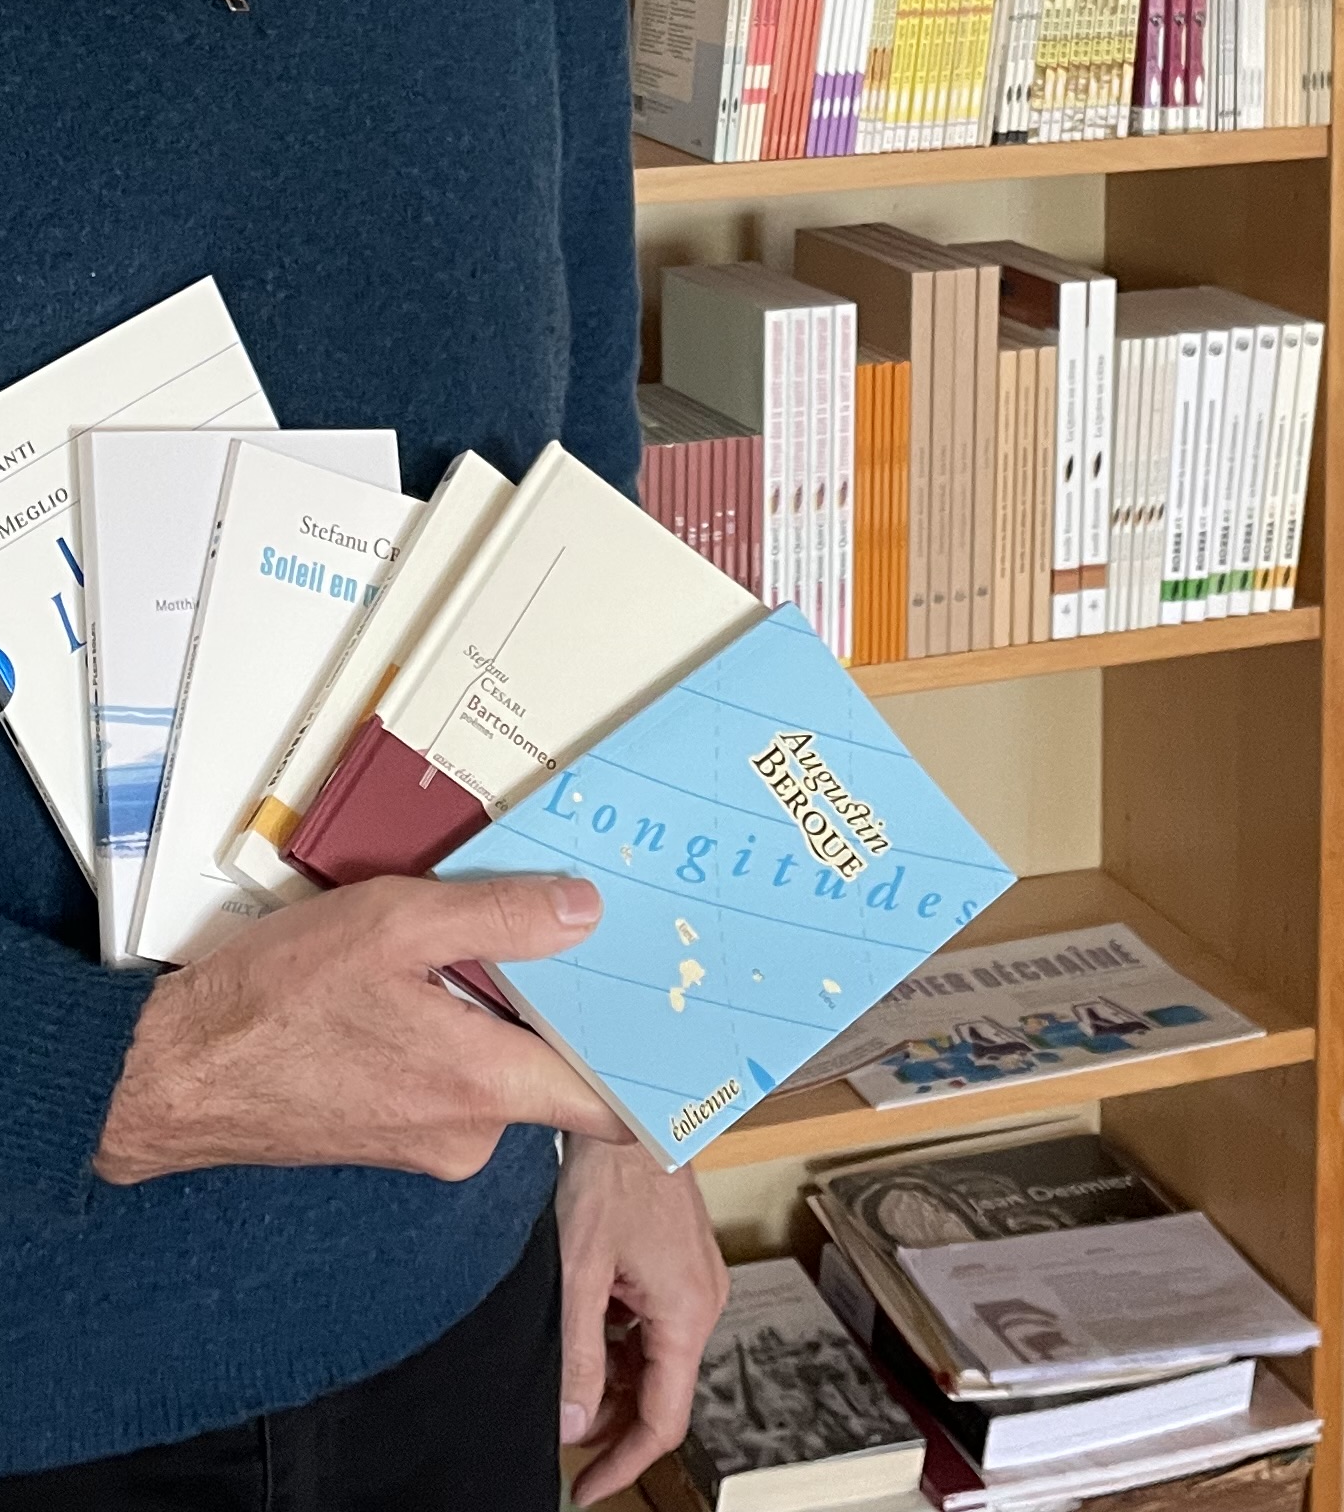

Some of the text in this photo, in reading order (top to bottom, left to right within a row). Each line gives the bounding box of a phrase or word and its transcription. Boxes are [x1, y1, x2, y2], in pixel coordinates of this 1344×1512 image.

[299, 514, 368, 555] Stefanu
[259, 545, 326, 594] Soleil
[329, 573, 358, 604] en
[463, 644, 510, 685] Stefanu
[479, 676, 527, 719] CESARI
[466, 693, 557, 772] Bartolomeo
[454, 764, 497, 803] éditions
[753, 744, 864, 879] BERQUE
[781, 731, 890, 854] Augustin
[543, 772, 979, 926] Longitudes
[672, 1078, 740, 1143] éolienne
